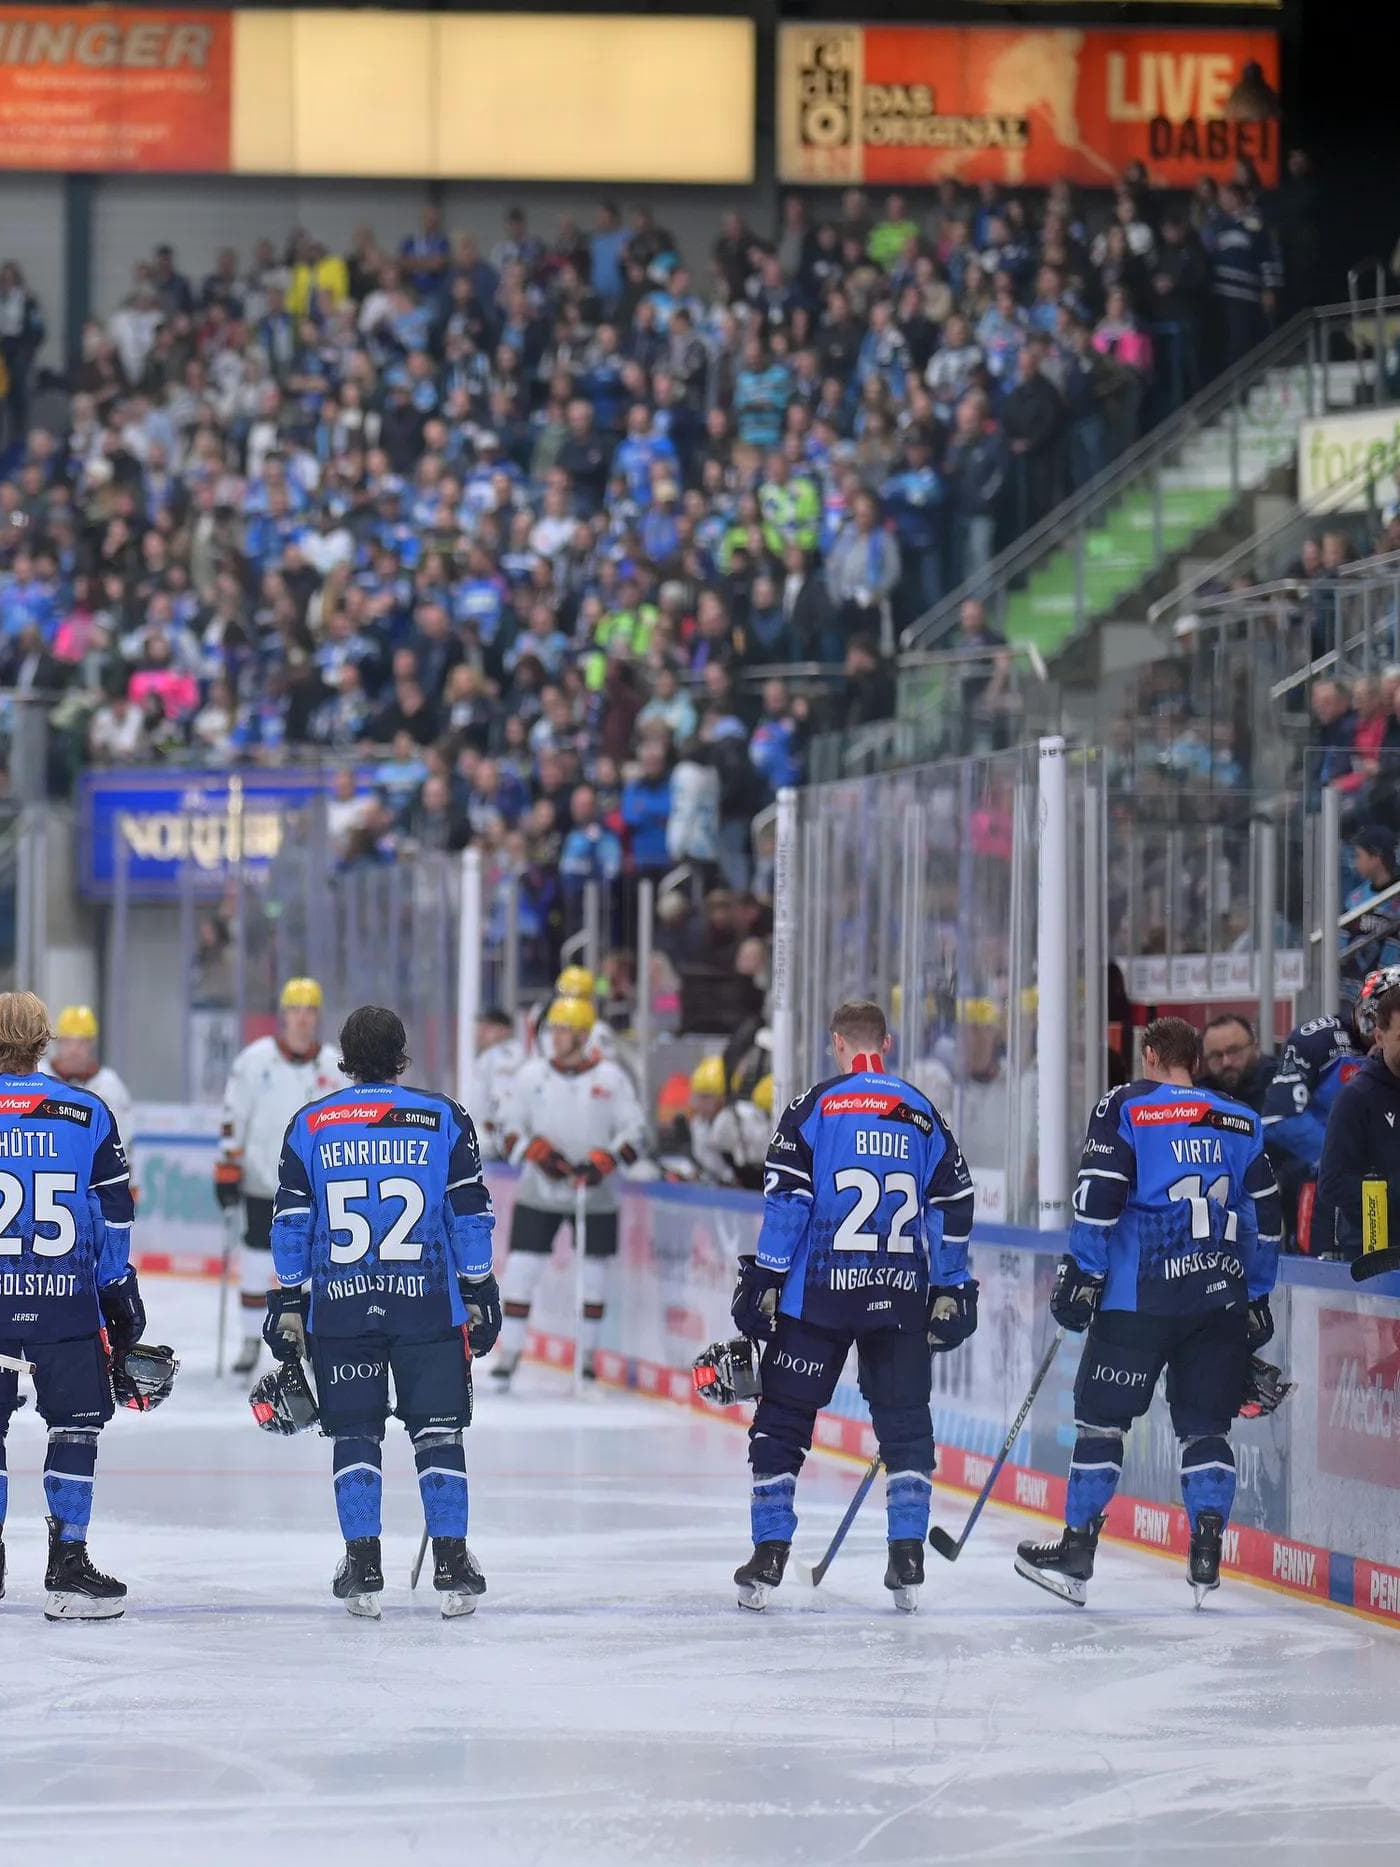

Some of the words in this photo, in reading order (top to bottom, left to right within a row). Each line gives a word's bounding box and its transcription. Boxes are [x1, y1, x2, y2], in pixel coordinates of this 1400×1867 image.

[863, 84, 934, 116] DAS
[1107, 51, 1236, 122] LIVE
[864, 115, 1029, 149] ORIGINAL
[1148, 115, 1271, 162] DABEI
[58, 1105, 88, 1122] SATURN
[405, 1112, 436, 1127] SATURN
[1222, 1116, 1251, 1132] SATURN
[319, 1139, 429, 1170] HENRIQUEZ
[855, 1129, 910, 1160] BODIE
[1170, 1138, 1223, 1164] VIRTA
[326, 1176, 427, 1265] 52
[832, 1167, 921, 1255] 22
[1167, 1174, 1239, 1243] 11
[326, 1274, 426, 1301] INGOLSTADT
[830, 1267, 918, 1293] INGOLSTADT
[773, 1350, 824, 1379] JOOP!
[1091, 1363, 1148, 1388] JOOP!
